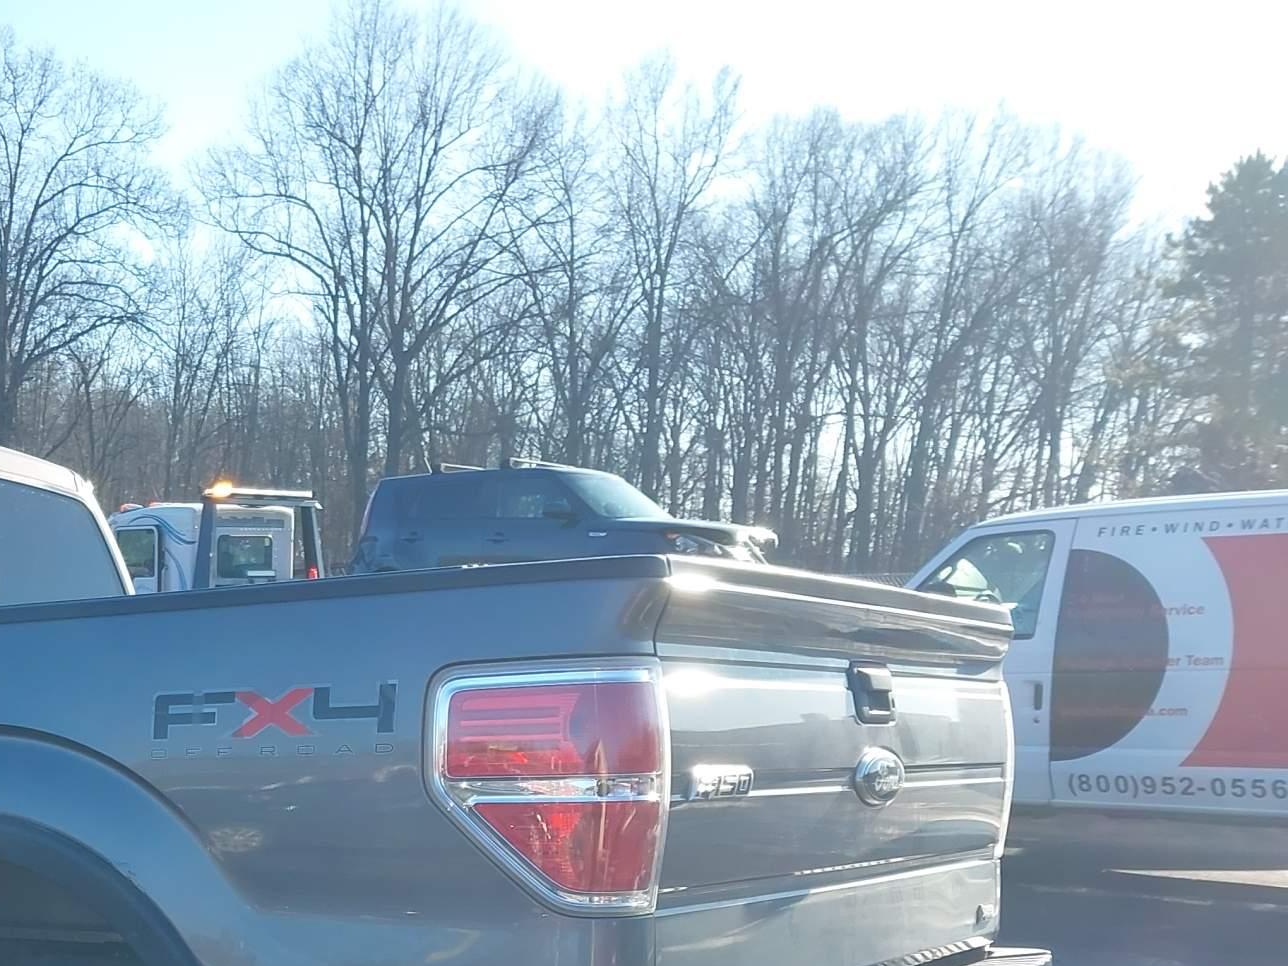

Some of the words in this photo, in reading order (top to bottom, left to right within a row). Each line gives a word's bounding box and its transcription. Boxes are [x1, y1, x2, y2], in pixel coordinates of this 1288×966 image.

[1097, 524, 1145, 538] FIRE
[1164, 520, 1221, 534] WIND
[1185, 654, 1225, 667] Team
[152, 680, 398, 741] FX4
